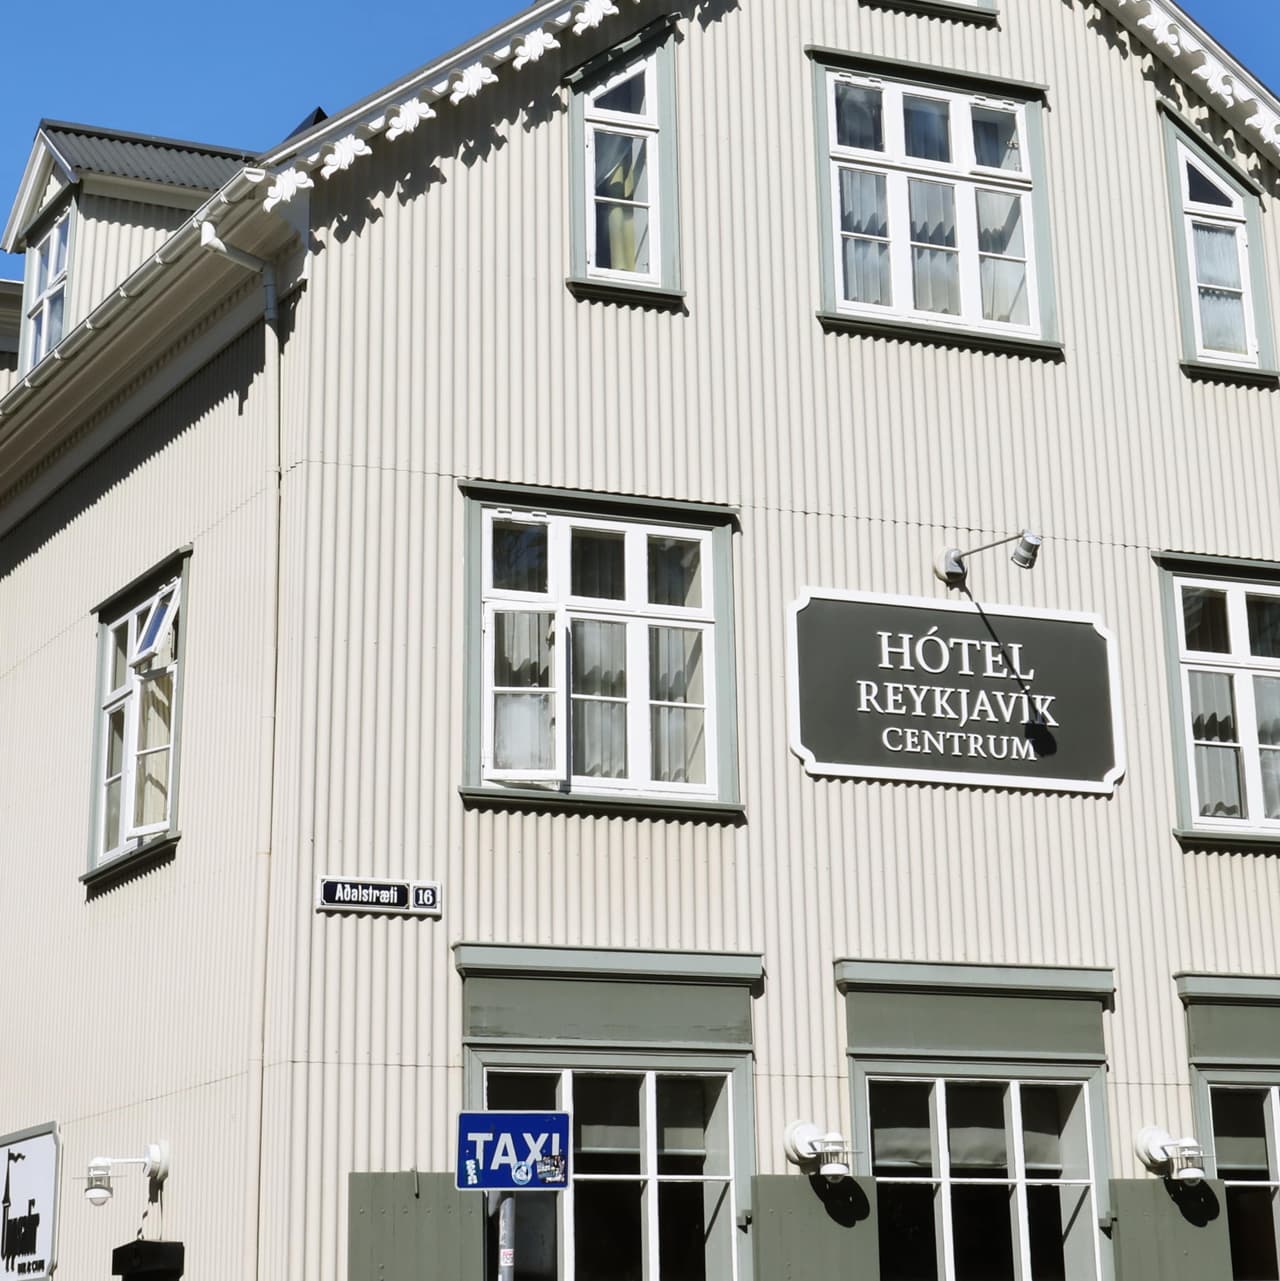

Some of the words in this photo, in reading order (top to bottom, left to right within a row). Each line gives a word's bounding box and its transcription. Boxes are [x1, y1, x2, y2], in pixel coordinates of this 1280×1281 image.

[876, 626, 1035, 681] HÓTEL
[856, 679, 1059, 728] REYKJAVÍK
[881, 726, 1038, 762] CENTRUM
[334, 882, 398, 904] Aðalstræti
[417, 889, 434, 905] 16
[467, 1132, 560, 1170] TAXI
